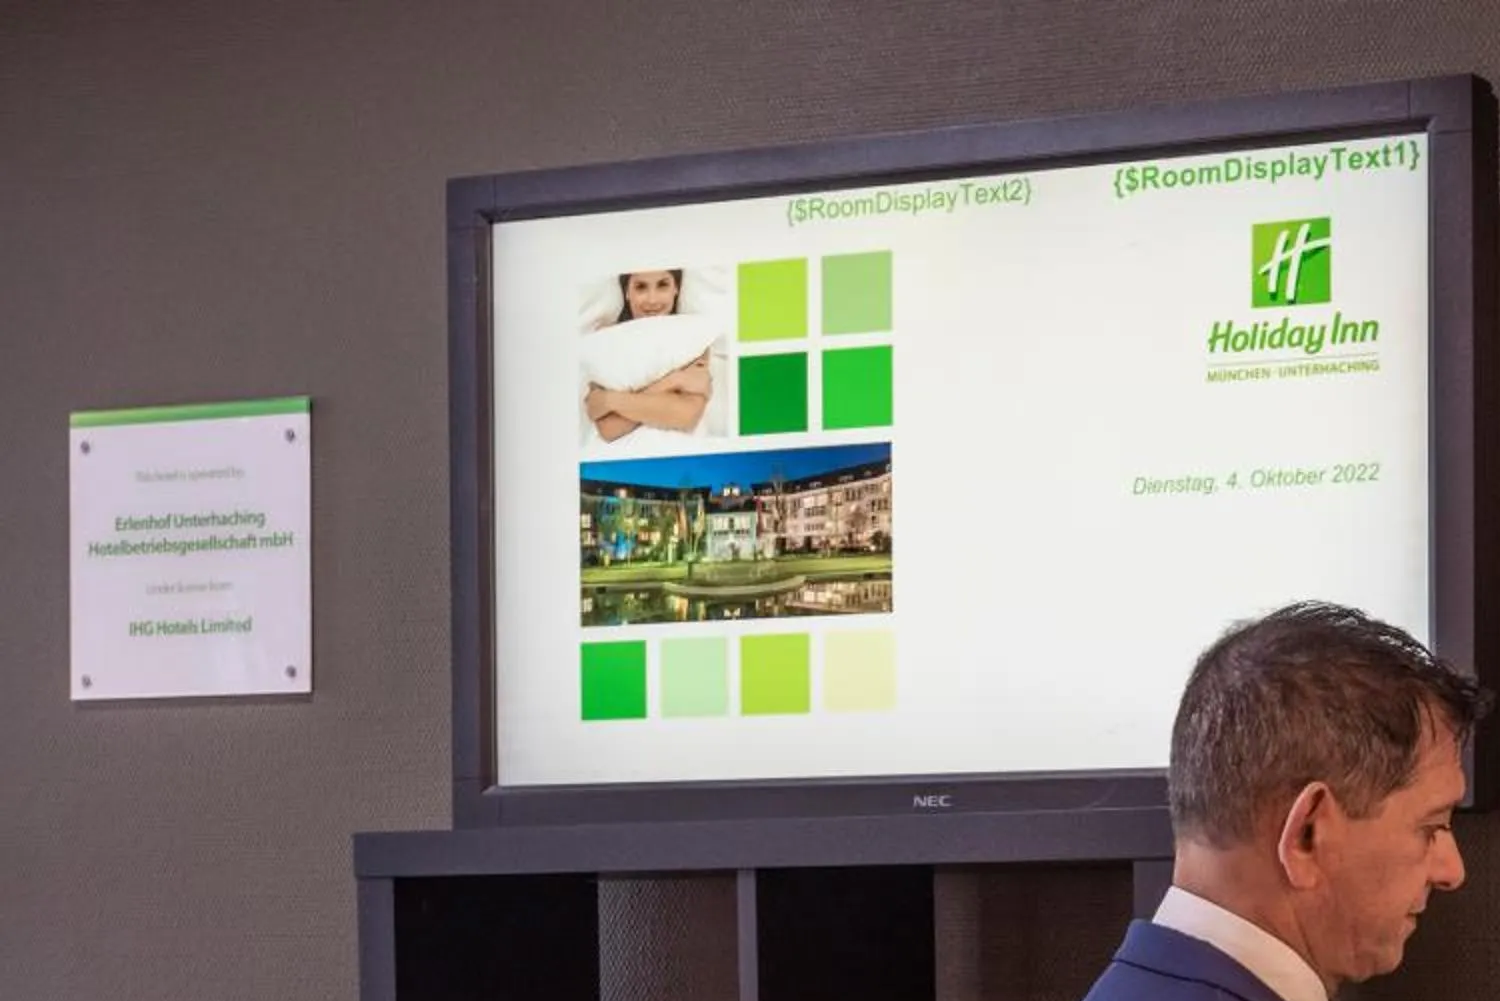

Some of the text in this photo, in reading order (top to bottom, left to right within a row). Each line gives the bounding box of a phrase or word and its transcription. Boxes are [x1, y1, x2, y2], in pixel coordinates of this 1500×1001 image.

[1114, 140, 1420, 198] {$RoomDisplayText1}
[787, 177, 1032, 226] {$RoomDisplayText2}
[1208, 311, 1379, 354] Holiday Inn
[1207, 360, 1380, 383] MÜNCHEN UNTERHACHING
[1133, 475, 1218, 495] Dienstag,
[1251, 468, 1326, 488] Oktober
[1332, 463, 1380, 483] 2022
[115, 511, 266, 531] Erlenhof Unterhaching
[88, 531, 293, 557] Hotelbetriebsgesellschaft mbH
[129, 615, 252, 637] IHG Hotels Limited
[913, 794, 953, 808] NEC
